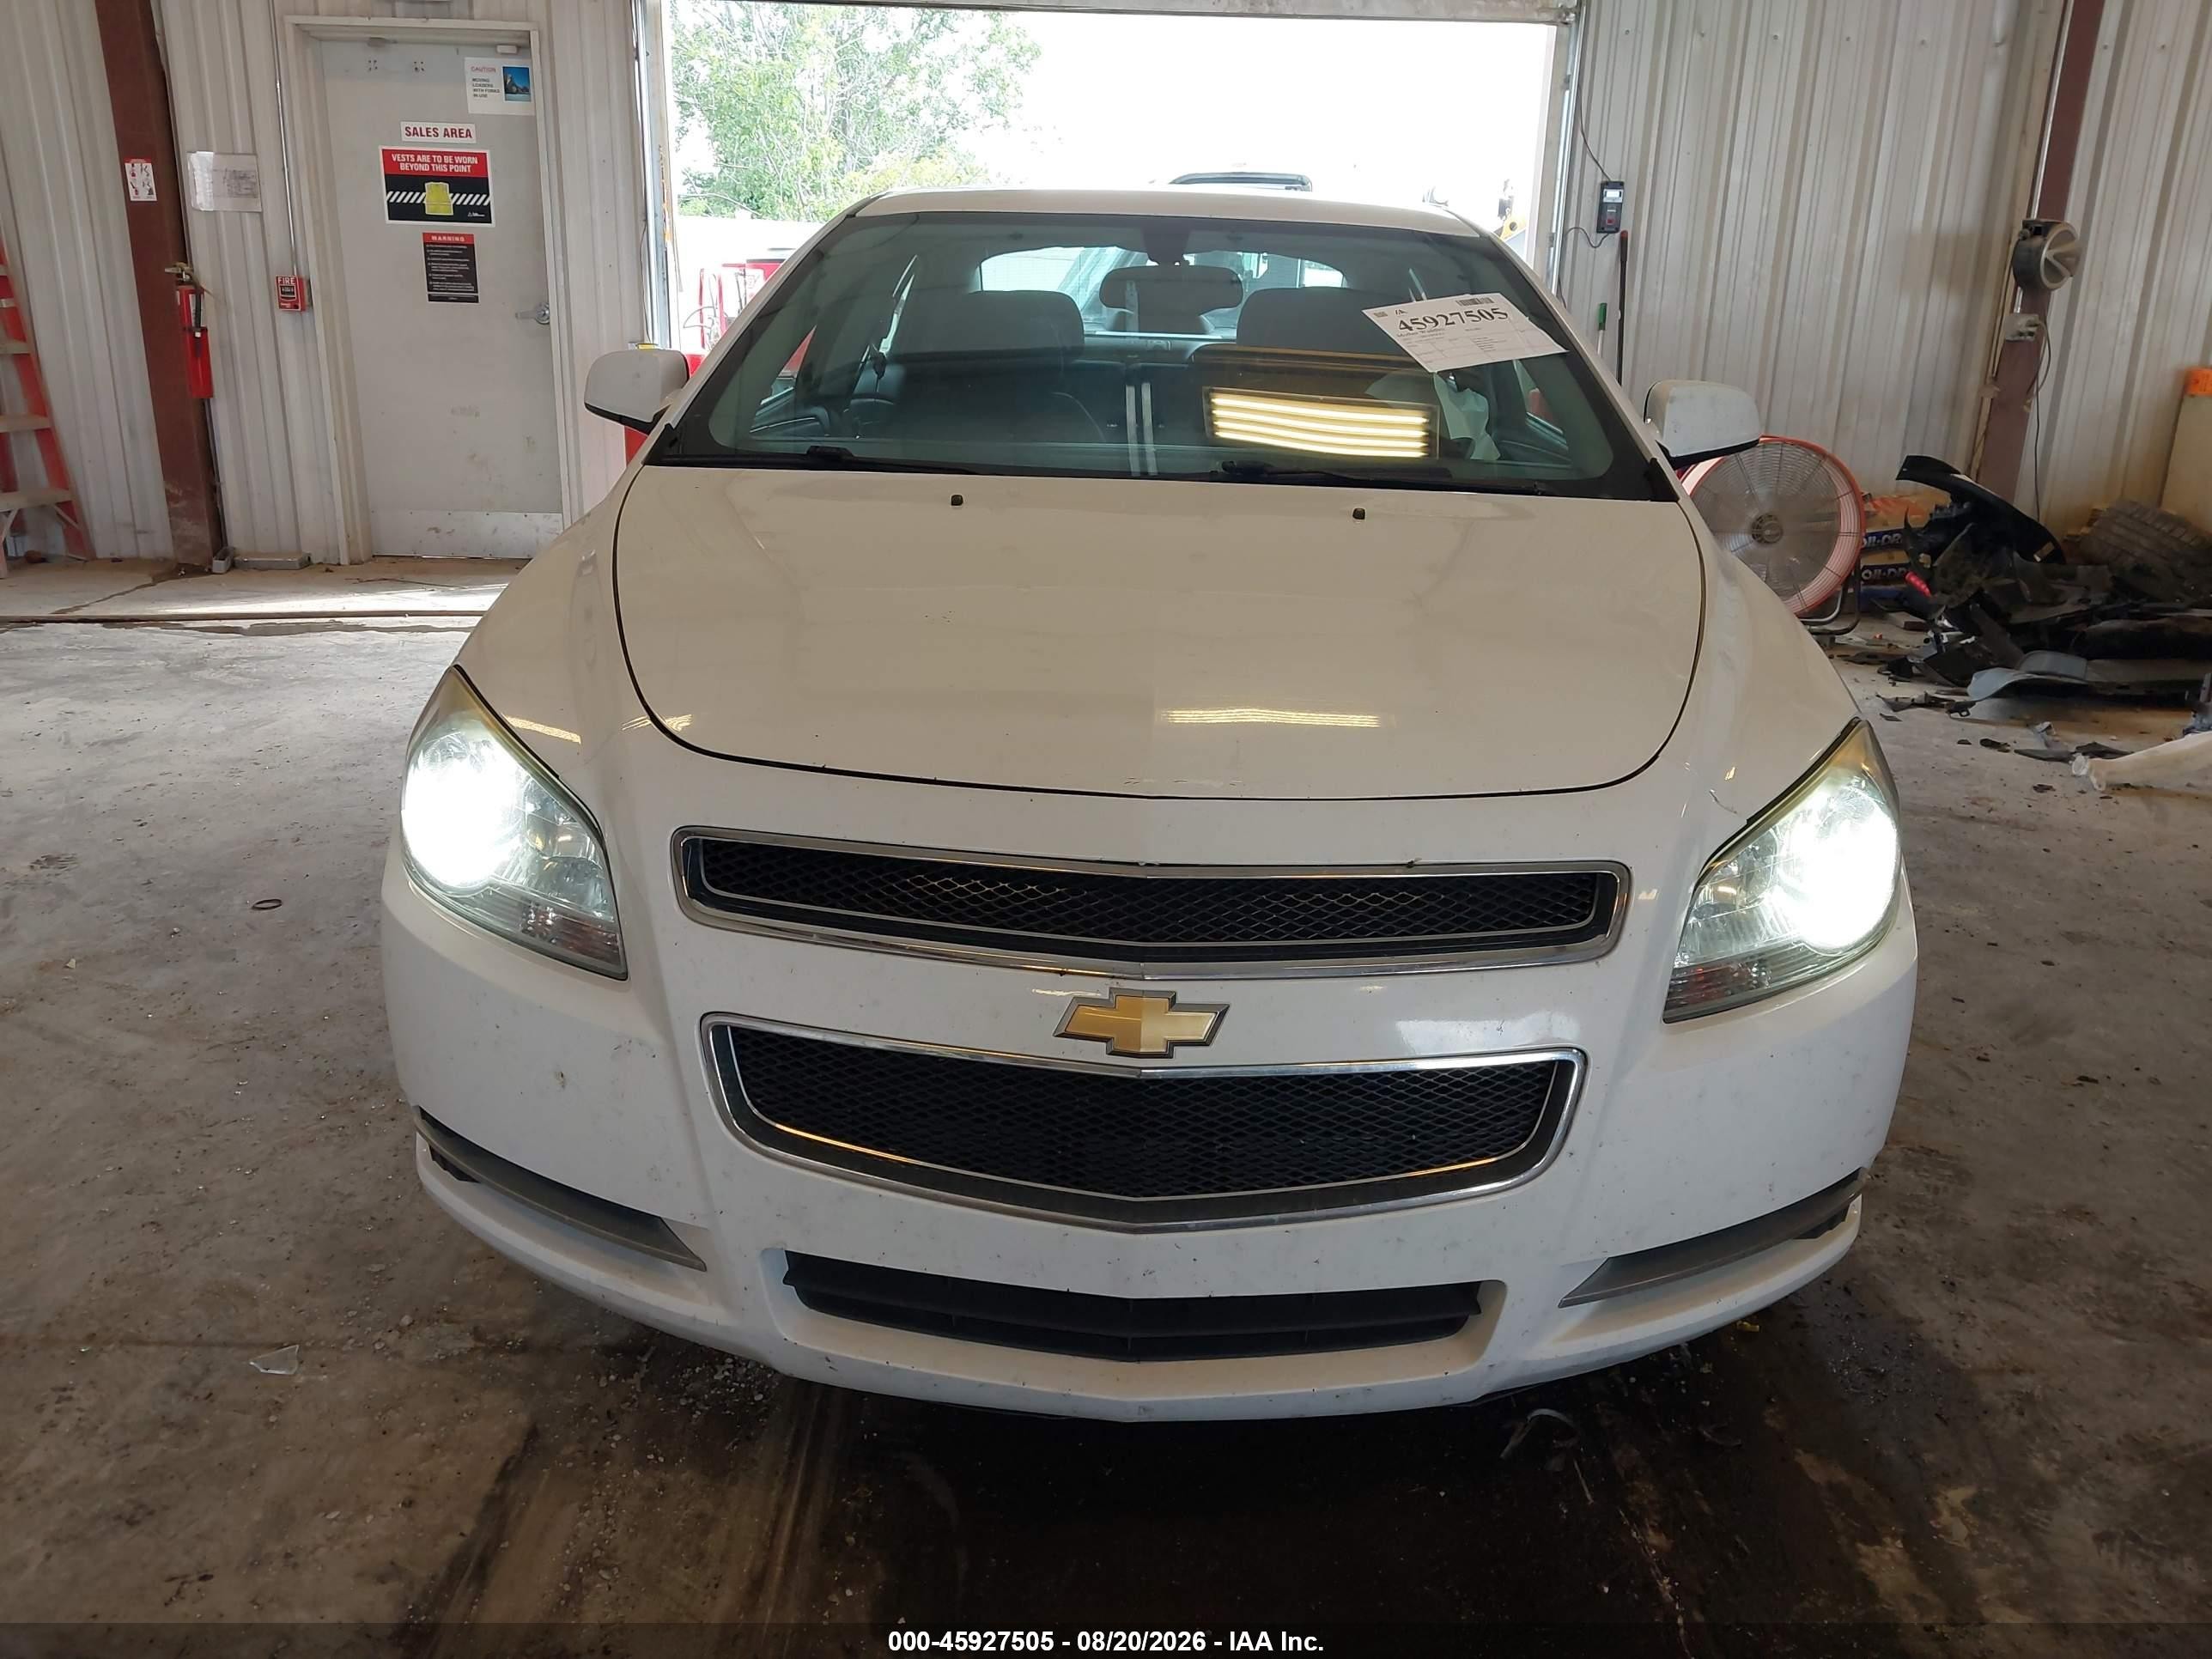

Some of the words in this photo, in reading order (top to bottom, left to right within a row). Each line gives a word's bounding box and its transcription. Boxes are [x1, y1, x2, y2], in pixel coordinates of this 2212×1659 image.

[404, 126, 439, 137] SALES
[443, 128, 472, 138] AREA
[392, 154, 415, 162] VESTS
[455, 156, 478, 165] WORN
[399, 162, 429, 172] BEYOND
[431, 163, 447, 172] THIS
[449, 164, 471, 173] POINT
[277, 276, 296, 285] FIRE
[1398, 307, 1509, 331] 45927505
